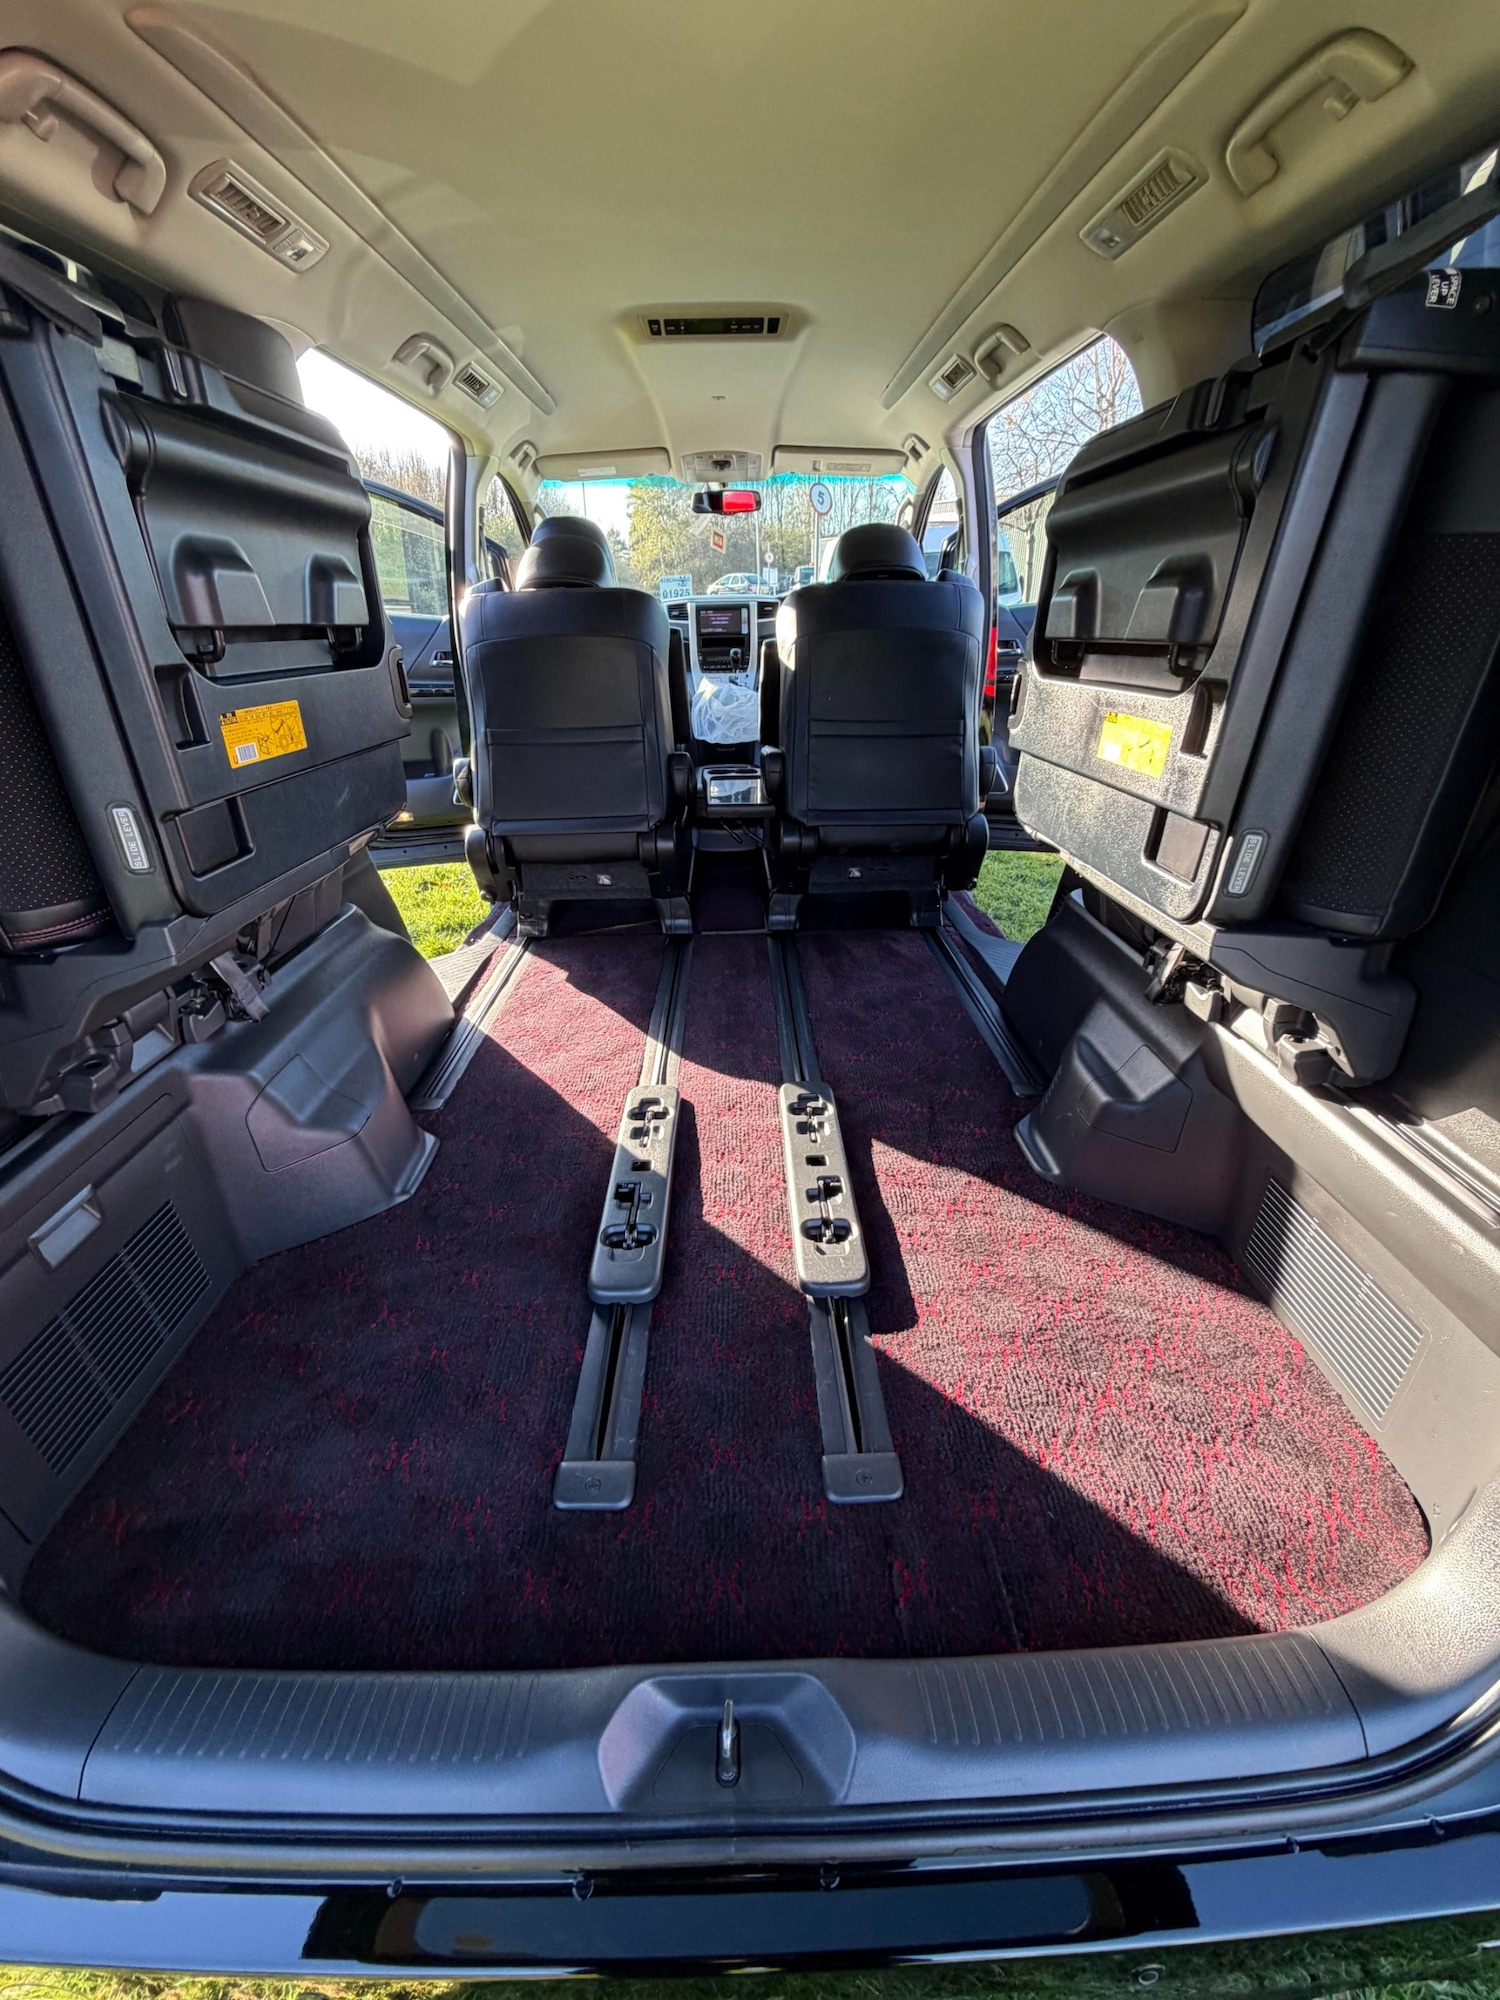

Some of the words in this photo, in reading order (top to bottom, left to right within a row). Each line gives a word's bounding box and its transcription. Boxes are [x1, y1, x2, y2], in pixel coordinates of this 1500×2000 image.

[1428, 274, 1441, 304] LEVER
[1440, 281, 1450, 296] UP
[1446, 275, 1459, 305] SPACE
[817, 490, 825, 506] 5
[662, 588, 690, 599] 01925
[118, 811, 134, 837] LEVER
[128, 841, 143, 867] SLIDE
[1242, 838, 1257, 864] SLIDE
[1233, 867, 1247, 892] LEVER
